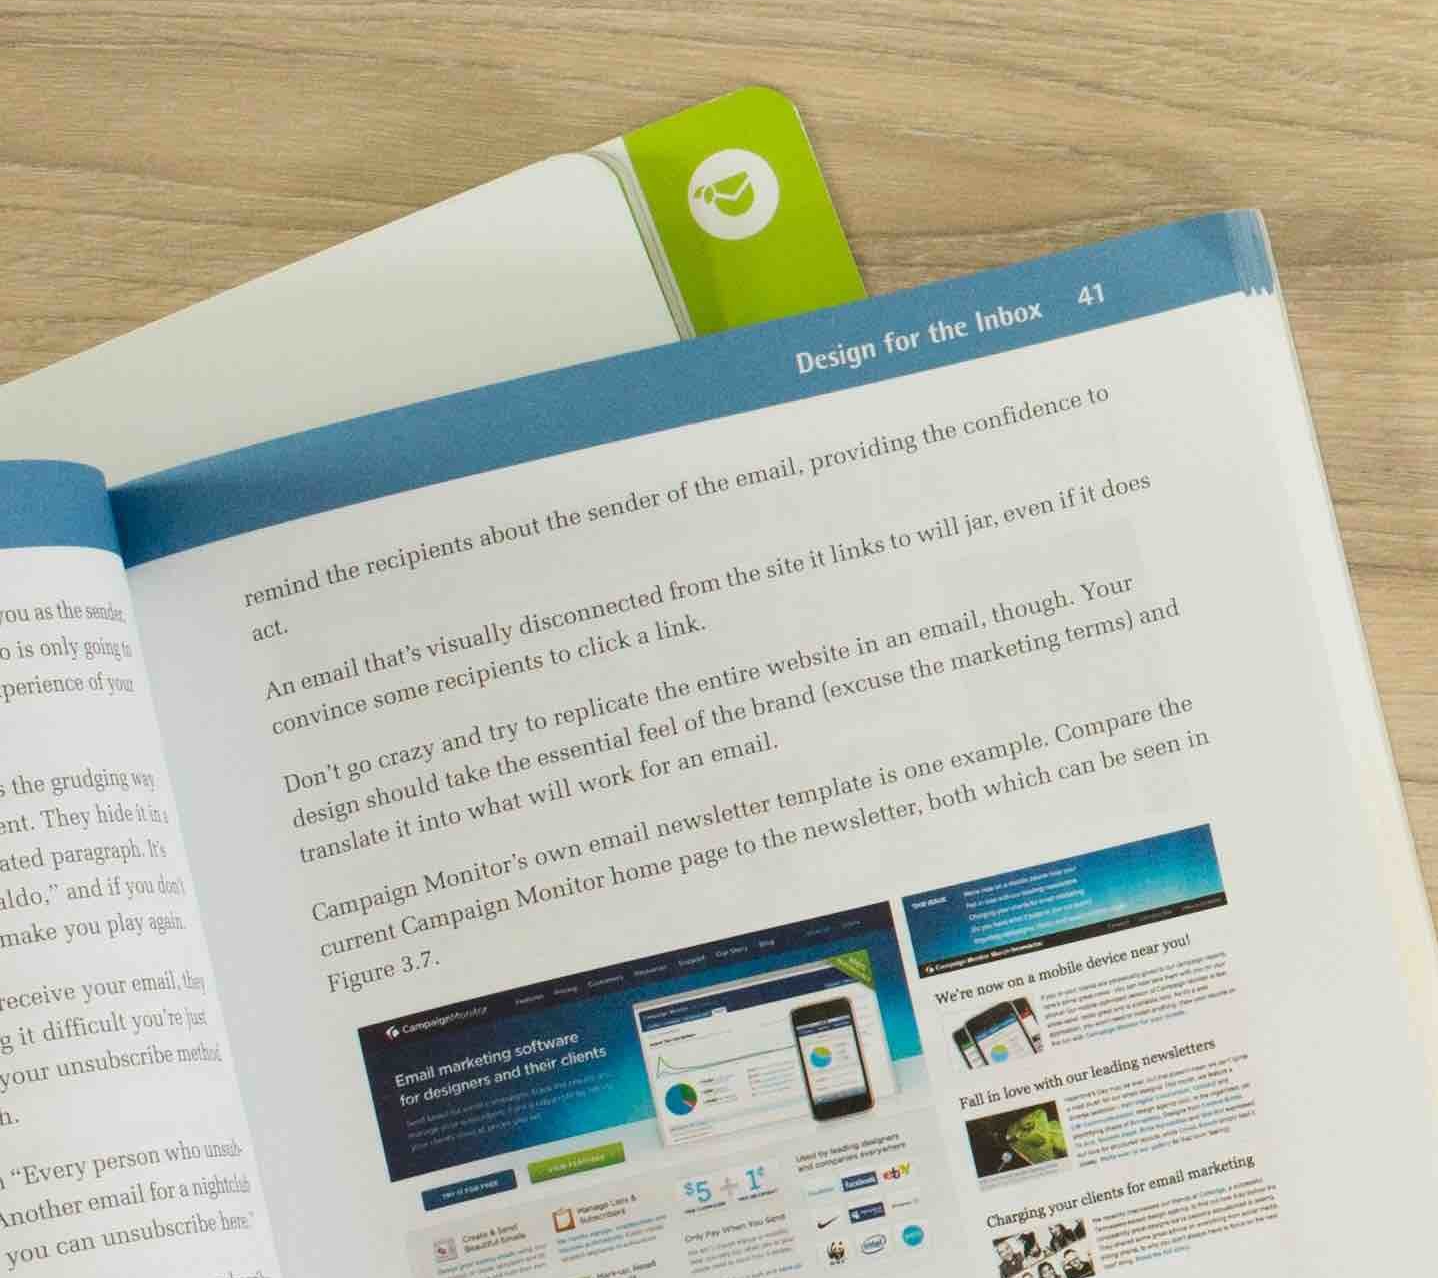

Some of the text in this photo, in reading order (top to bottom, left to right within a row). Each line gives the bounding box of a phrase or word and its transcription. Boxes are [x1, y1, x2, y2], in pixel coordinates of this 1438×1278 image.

[795, 283, 1105, 375] Design for the Inbox 41
[244, 388, 1109, 608] remind the recipients about the sender of the email, providing the confidence to
[251, 619, 288, 642] act.
[326, 949, 440, 993] Figure 3.7.
[933, 932, 1191, 1005] We're now on a mobile device near you!
[394, 1033, 579, 1088] Email marketing software
[399, 1046, 607, 1107] for designers and their clients
[986, 1155, 1256, 1229] Charging your clients for email marketing
